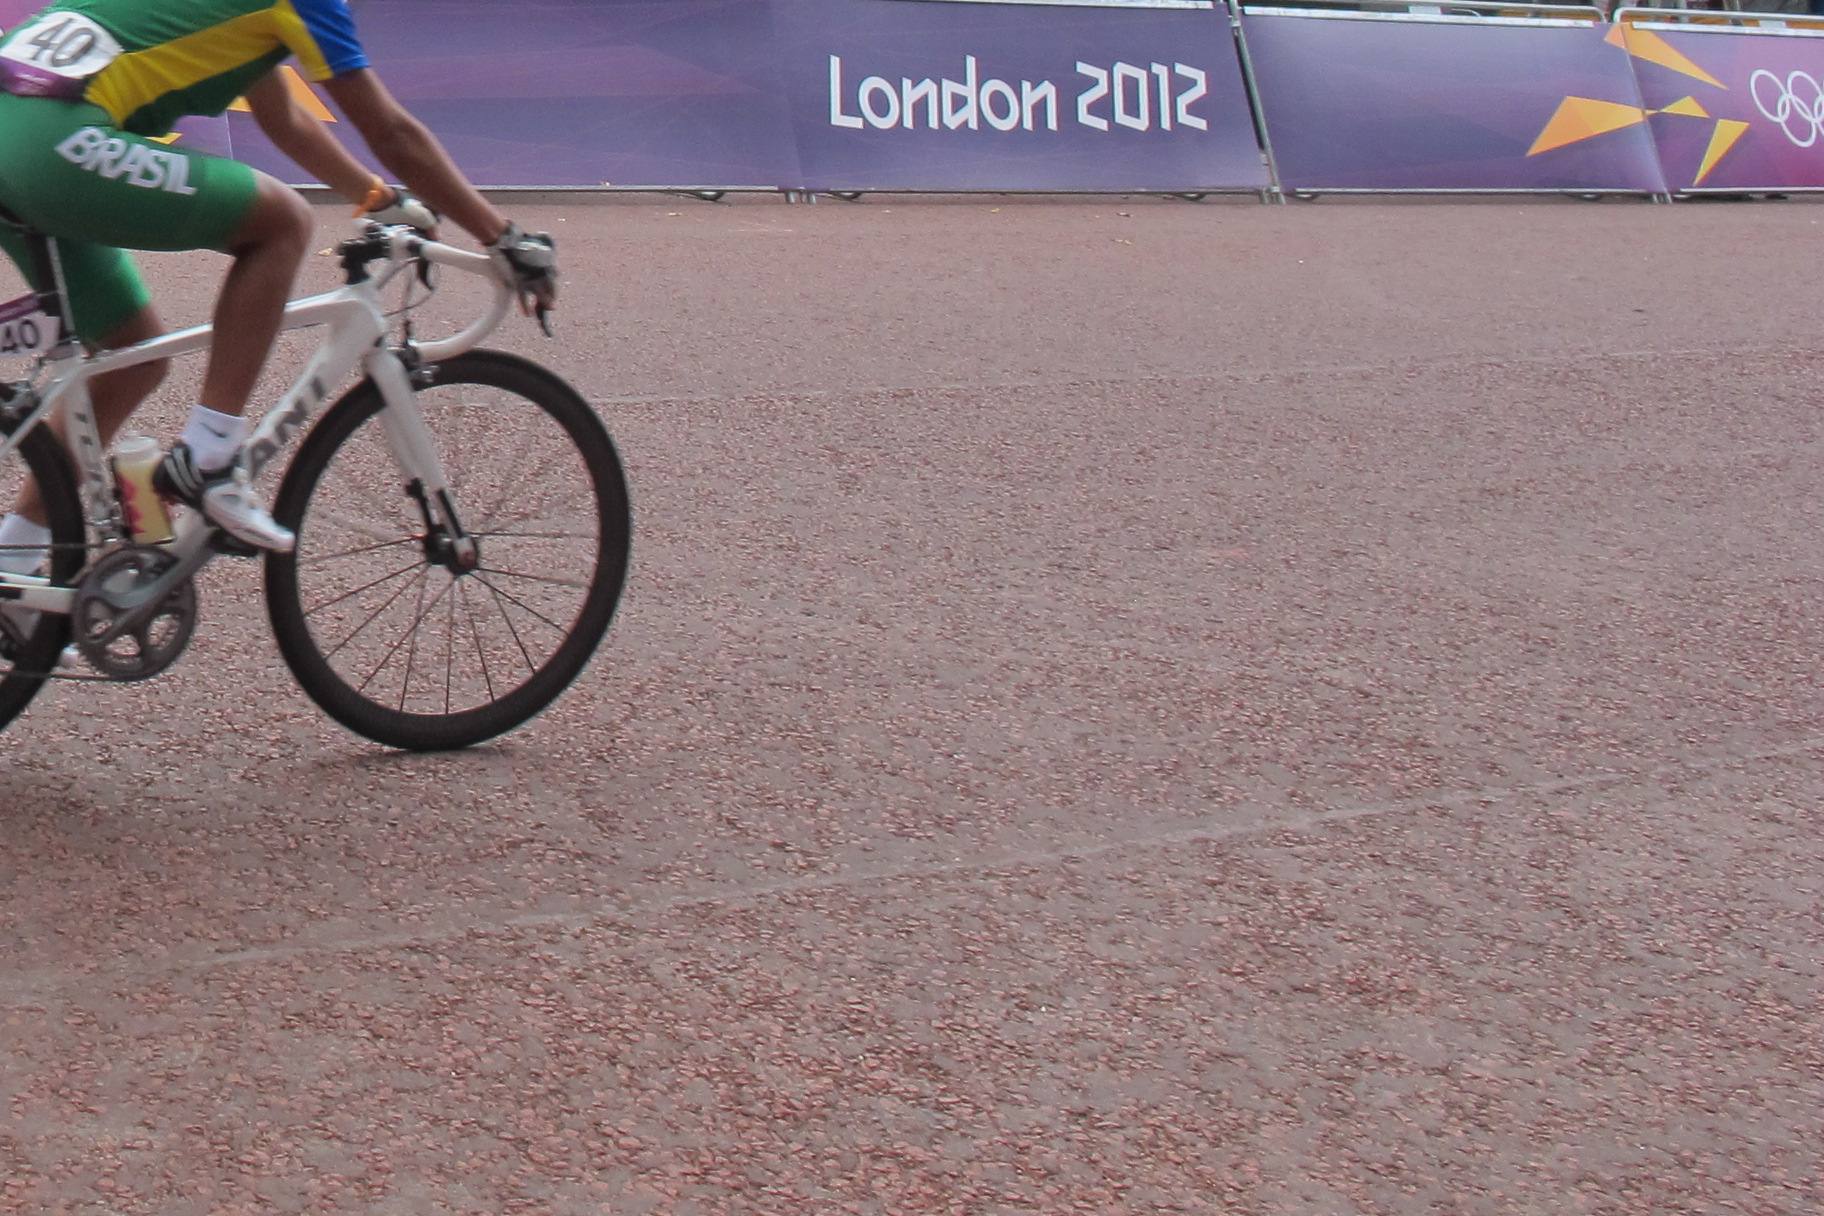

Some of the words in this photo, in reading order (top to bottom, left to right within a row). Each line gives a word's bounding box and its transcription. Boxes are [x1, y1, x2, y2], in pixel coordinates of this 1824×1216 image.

[29, 17, 96, 67] 40
[828, 54, 1058, 132] London
[1075, 61, 1208, 132] 2012
[53, 125, 197, 196] BRASIL
[0, 318, 41, 354] 40
